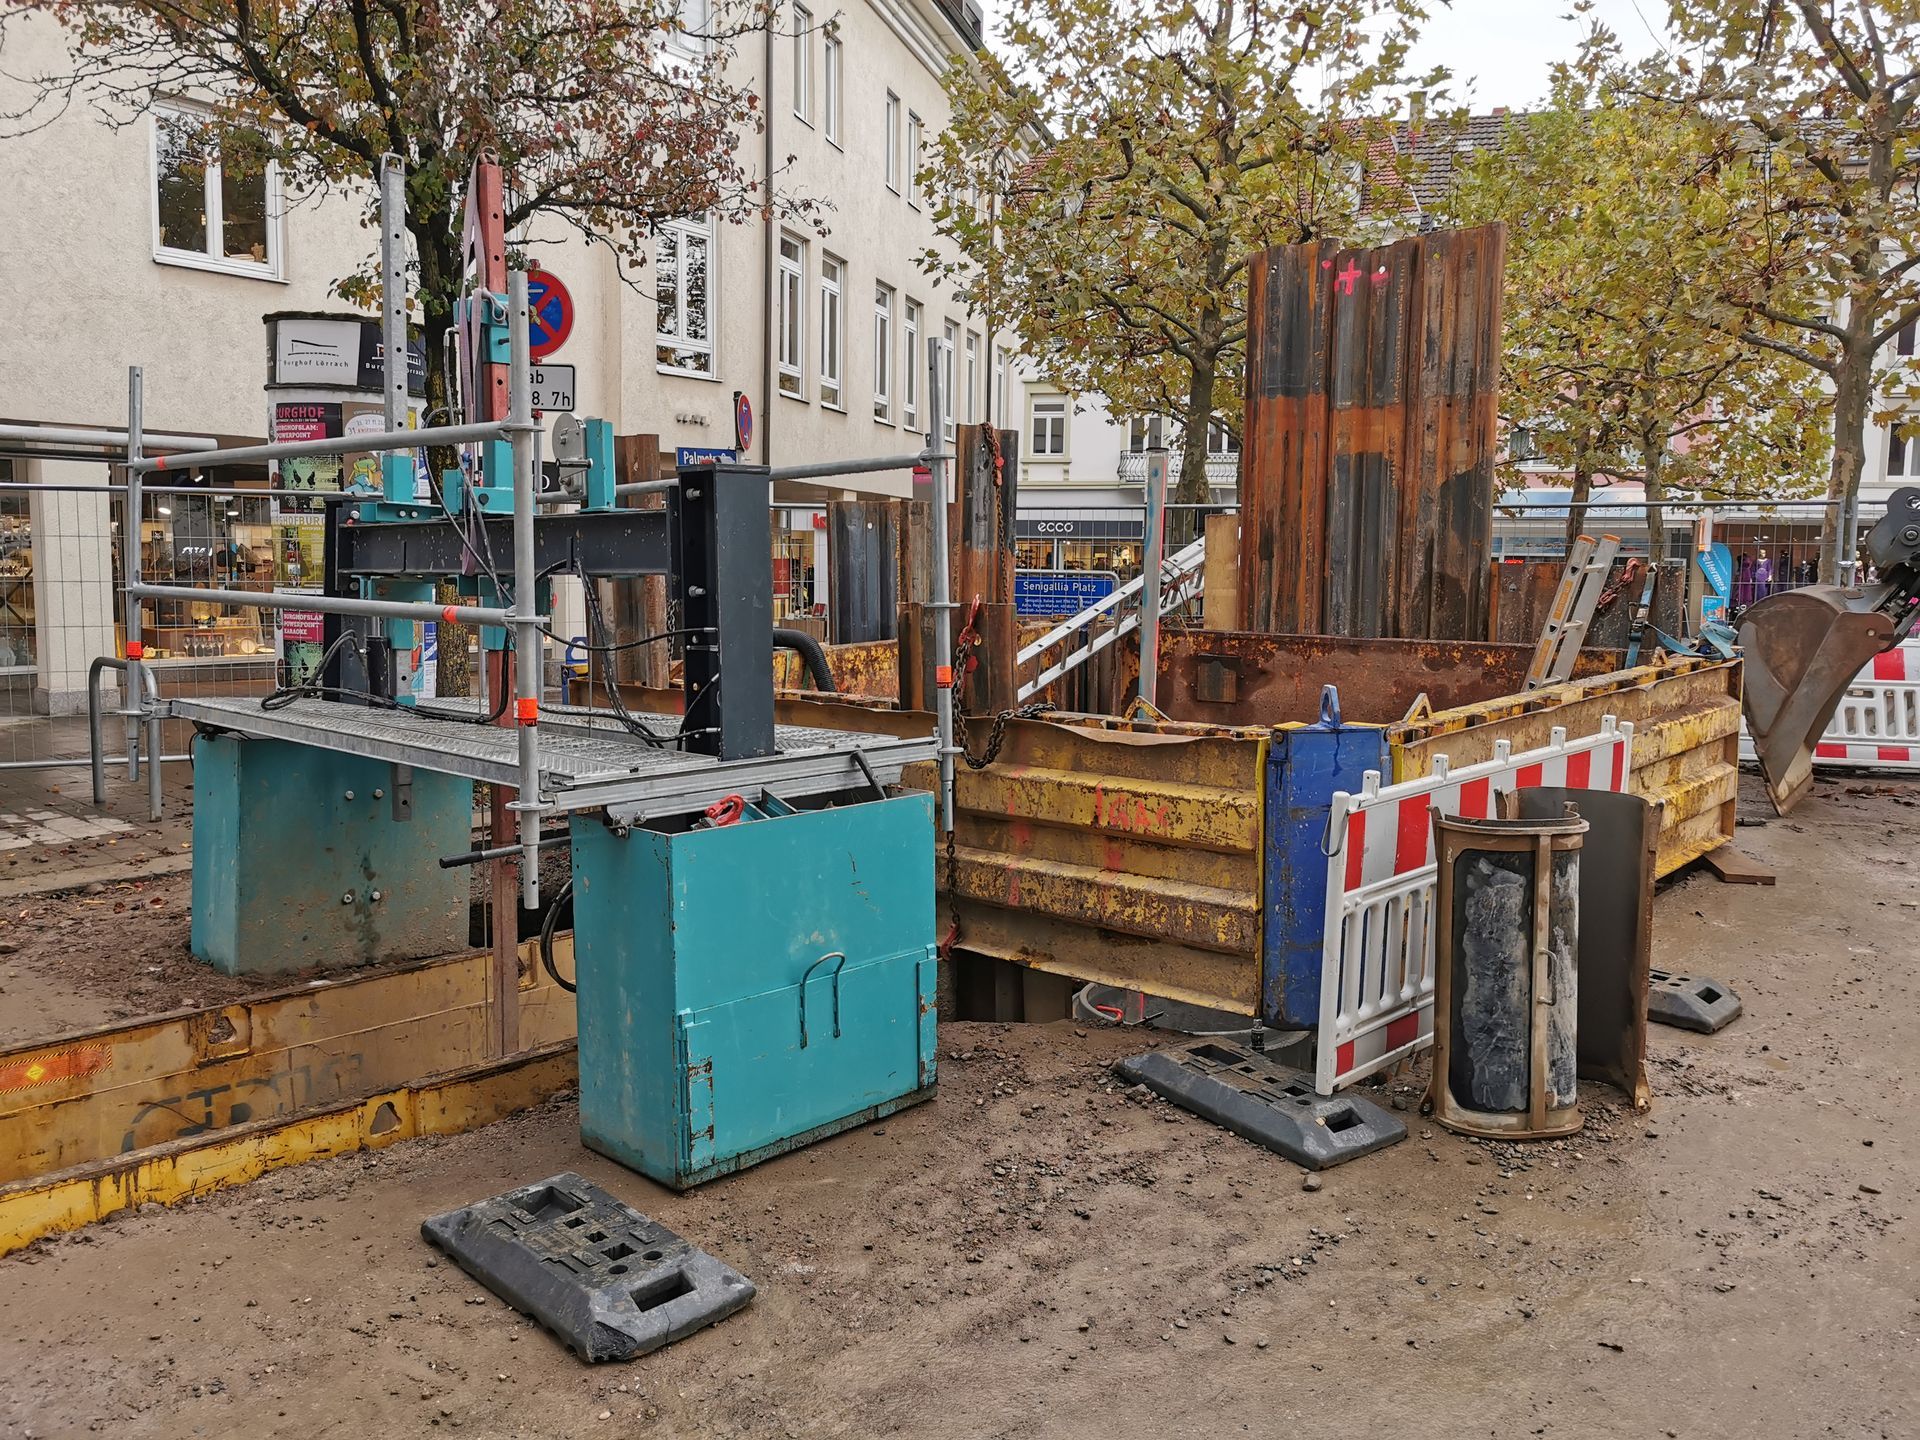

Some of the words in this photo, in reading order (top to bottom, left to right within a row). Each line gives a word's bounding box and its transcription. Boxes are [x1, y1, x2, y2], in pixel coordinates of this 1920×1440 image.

[315, 359, 349, 368] Lörrach
[276, 406, 325, 419] URGHOF
[1037, 522, 1074, 532] ecco
[1705, 560, 1728, 592] Hermes
[1023, 581, 1069, 593] Senigallia
[1072, 582, 1096, 593] Platz
